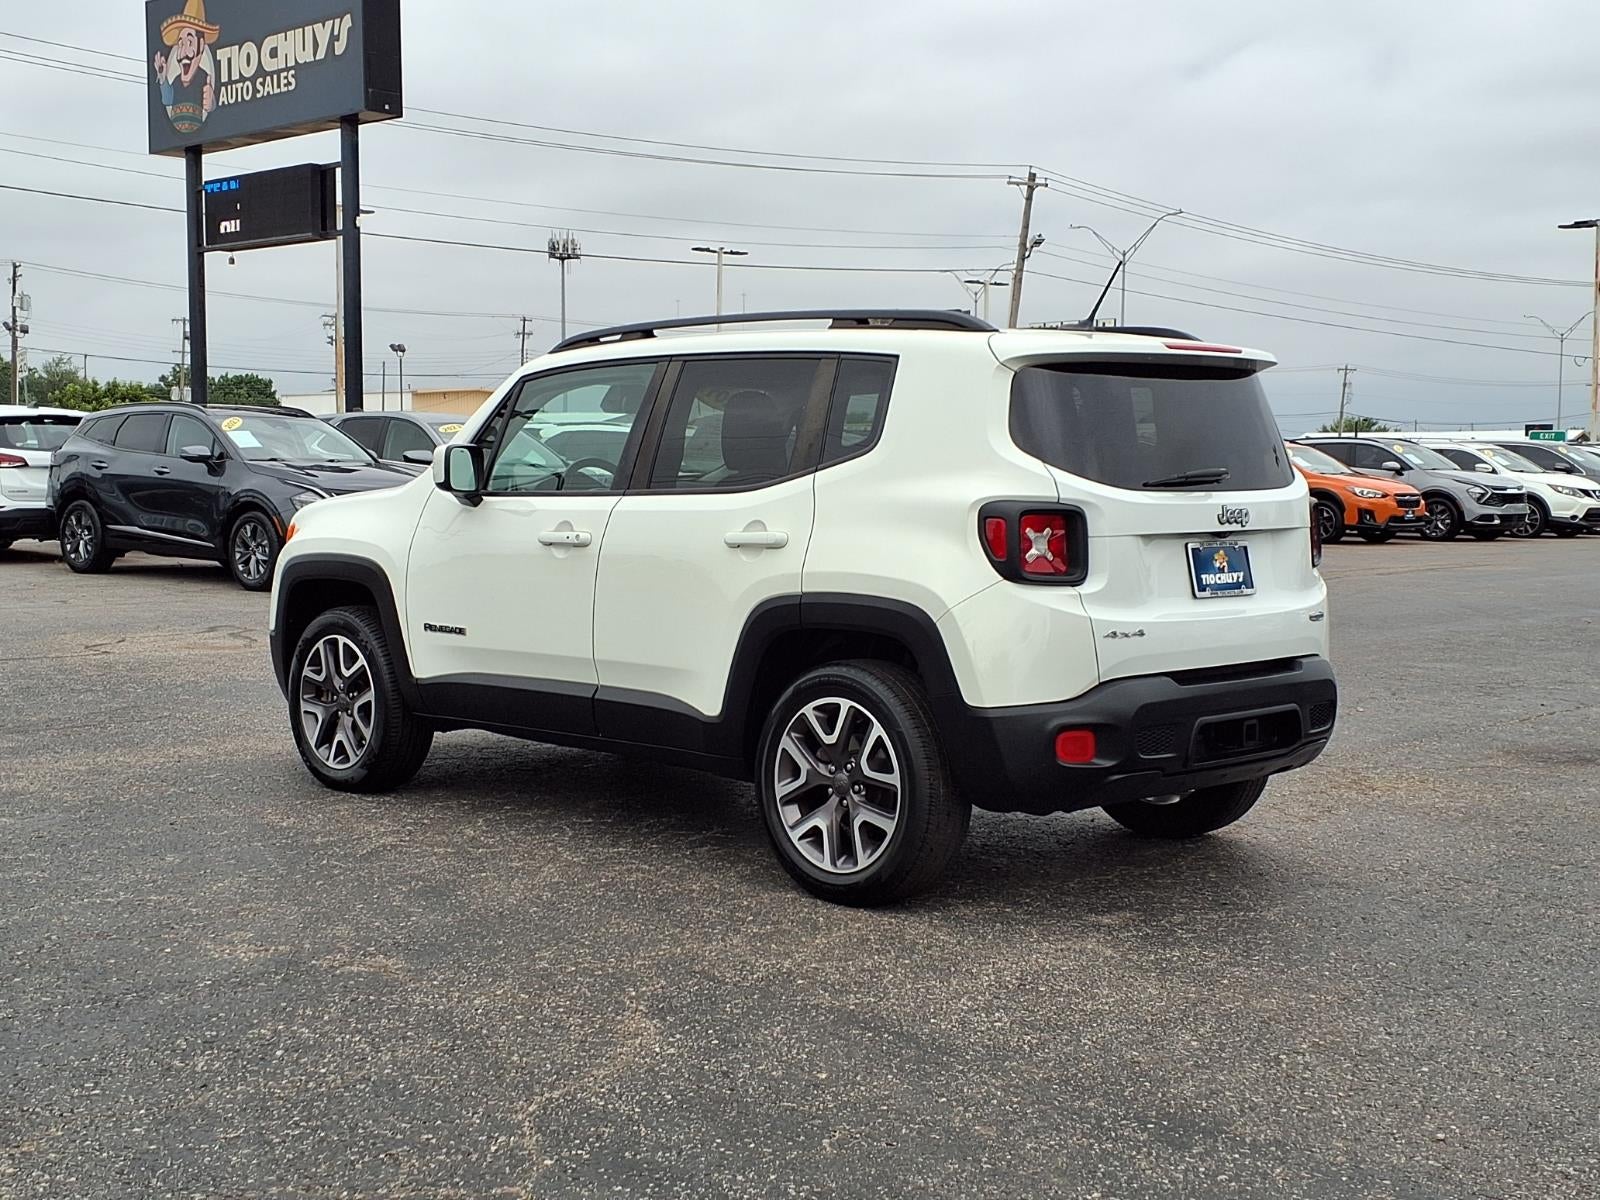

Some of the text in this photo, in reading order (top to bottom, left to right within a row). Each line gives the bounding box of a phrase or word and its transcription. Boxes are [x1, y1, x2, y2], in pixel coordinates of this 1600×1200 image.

[216, 13, 352, 83] TIO CHUY'S
[218, 69, 296, 106] AUTO SALES
[1539, 432, 1556, 440] EXIT
[1217, 504, 1250, 528] Jeep
[1201, 574, 1216, 585] TIO
